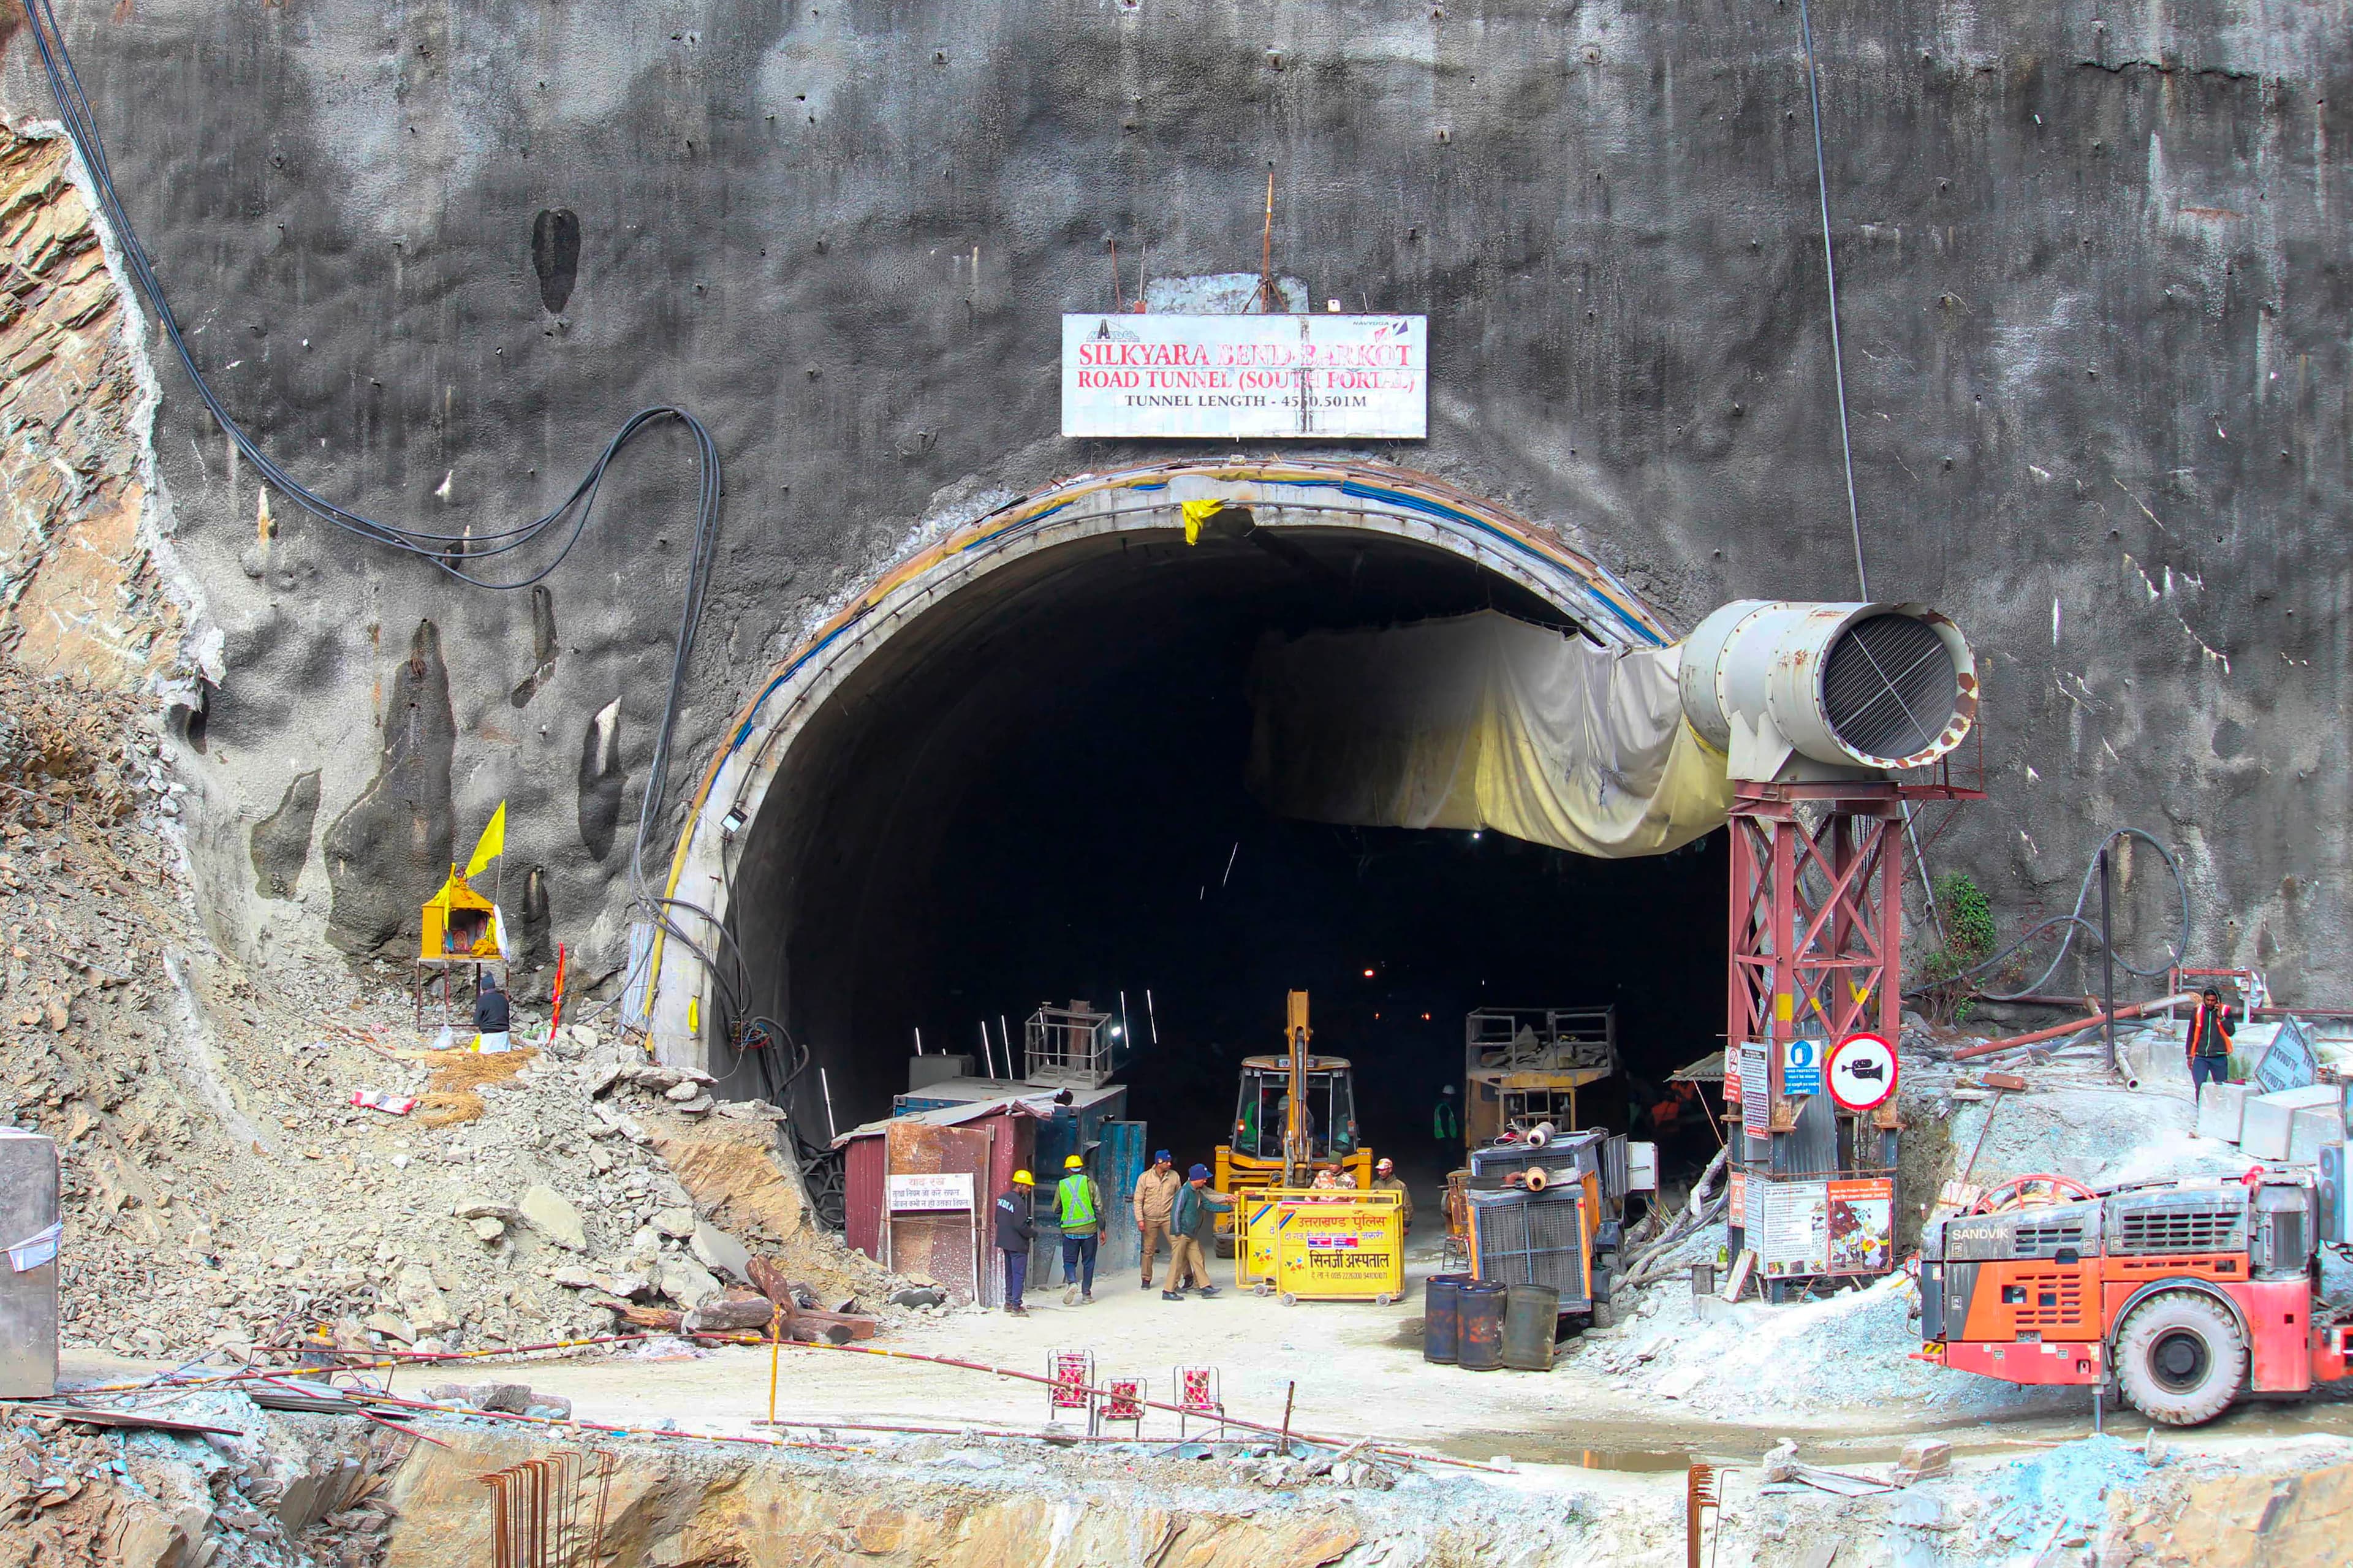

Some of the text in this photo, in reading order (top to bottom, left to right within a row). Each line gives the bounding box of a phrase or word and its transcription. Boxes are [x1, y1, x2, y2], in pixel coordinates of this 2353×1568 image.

[1079, 344, 1210, 366] SILKYARA
[1078, 371, 1415, 393] ROAD TUNNEL (SOUTH PORTAL)
[1125, 395, 1193, 407] TUNNEL
[1198, 395, 1266, 407] LENGTH
[1298, 1213, 1387, 1230] उत्तराखण्ड पुलिस
[1952, 1228, 2009, 1240] SANDVIK
[1309, 1249, 1390, 1268] सिनर्जी अस्पताल
